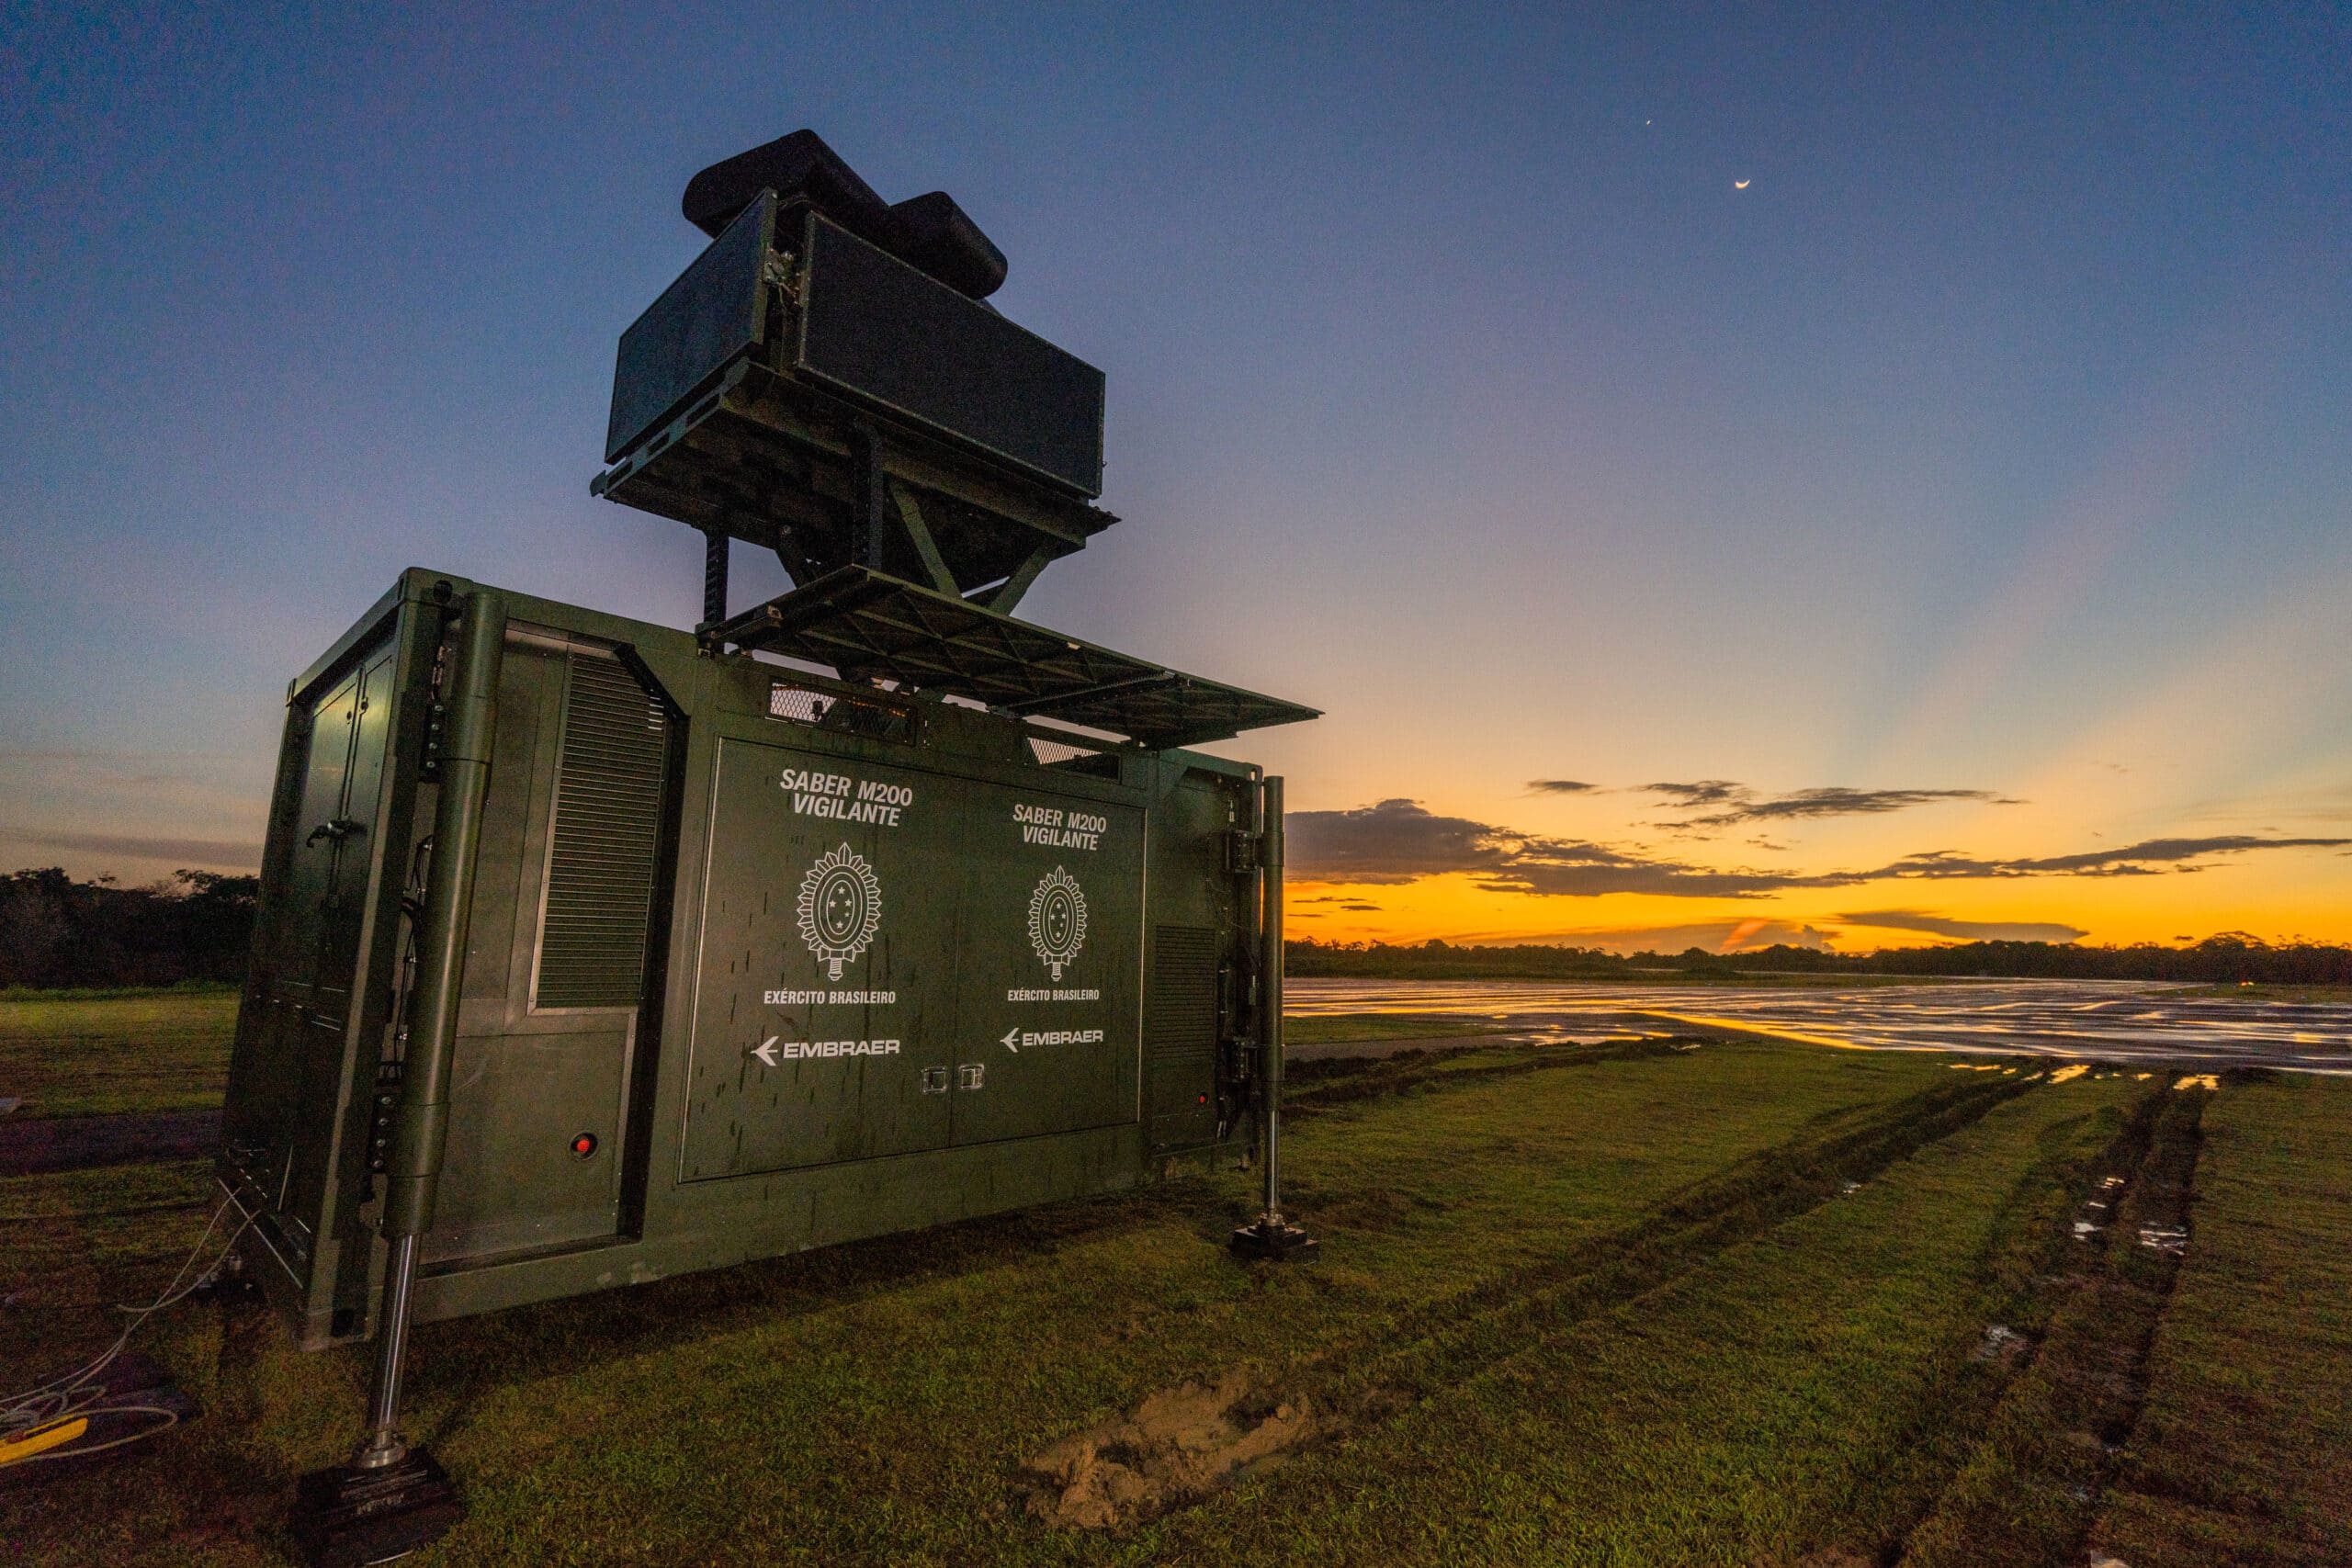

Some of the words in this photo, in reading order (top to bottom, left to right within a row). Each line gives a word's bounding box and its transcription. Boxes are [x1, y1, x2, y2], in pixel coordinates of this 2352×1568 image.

[780, 769, 851, 796] SABER
[857, 780, 913, 807] M200
[794, 792, 901, 827] VIGILANTE
[1012, 804, 1063, 828] SABER
[1068, 812, 1107, 833] M200
[1023, 825, 1099, 851] VIGILANTE
[763, 987, 825, 1004] EXÉRCITO
[829, 990, 896, 1004] BRASILEIRO
[1007, 987, 1050, 1001] EXÉRCITO
[1052, 988, 1100, 1001] BRASILEIRO
[783, 1039, 900, 1059] EMBRAER
[1023, 1029, 1103, 1047] EMBRAER
